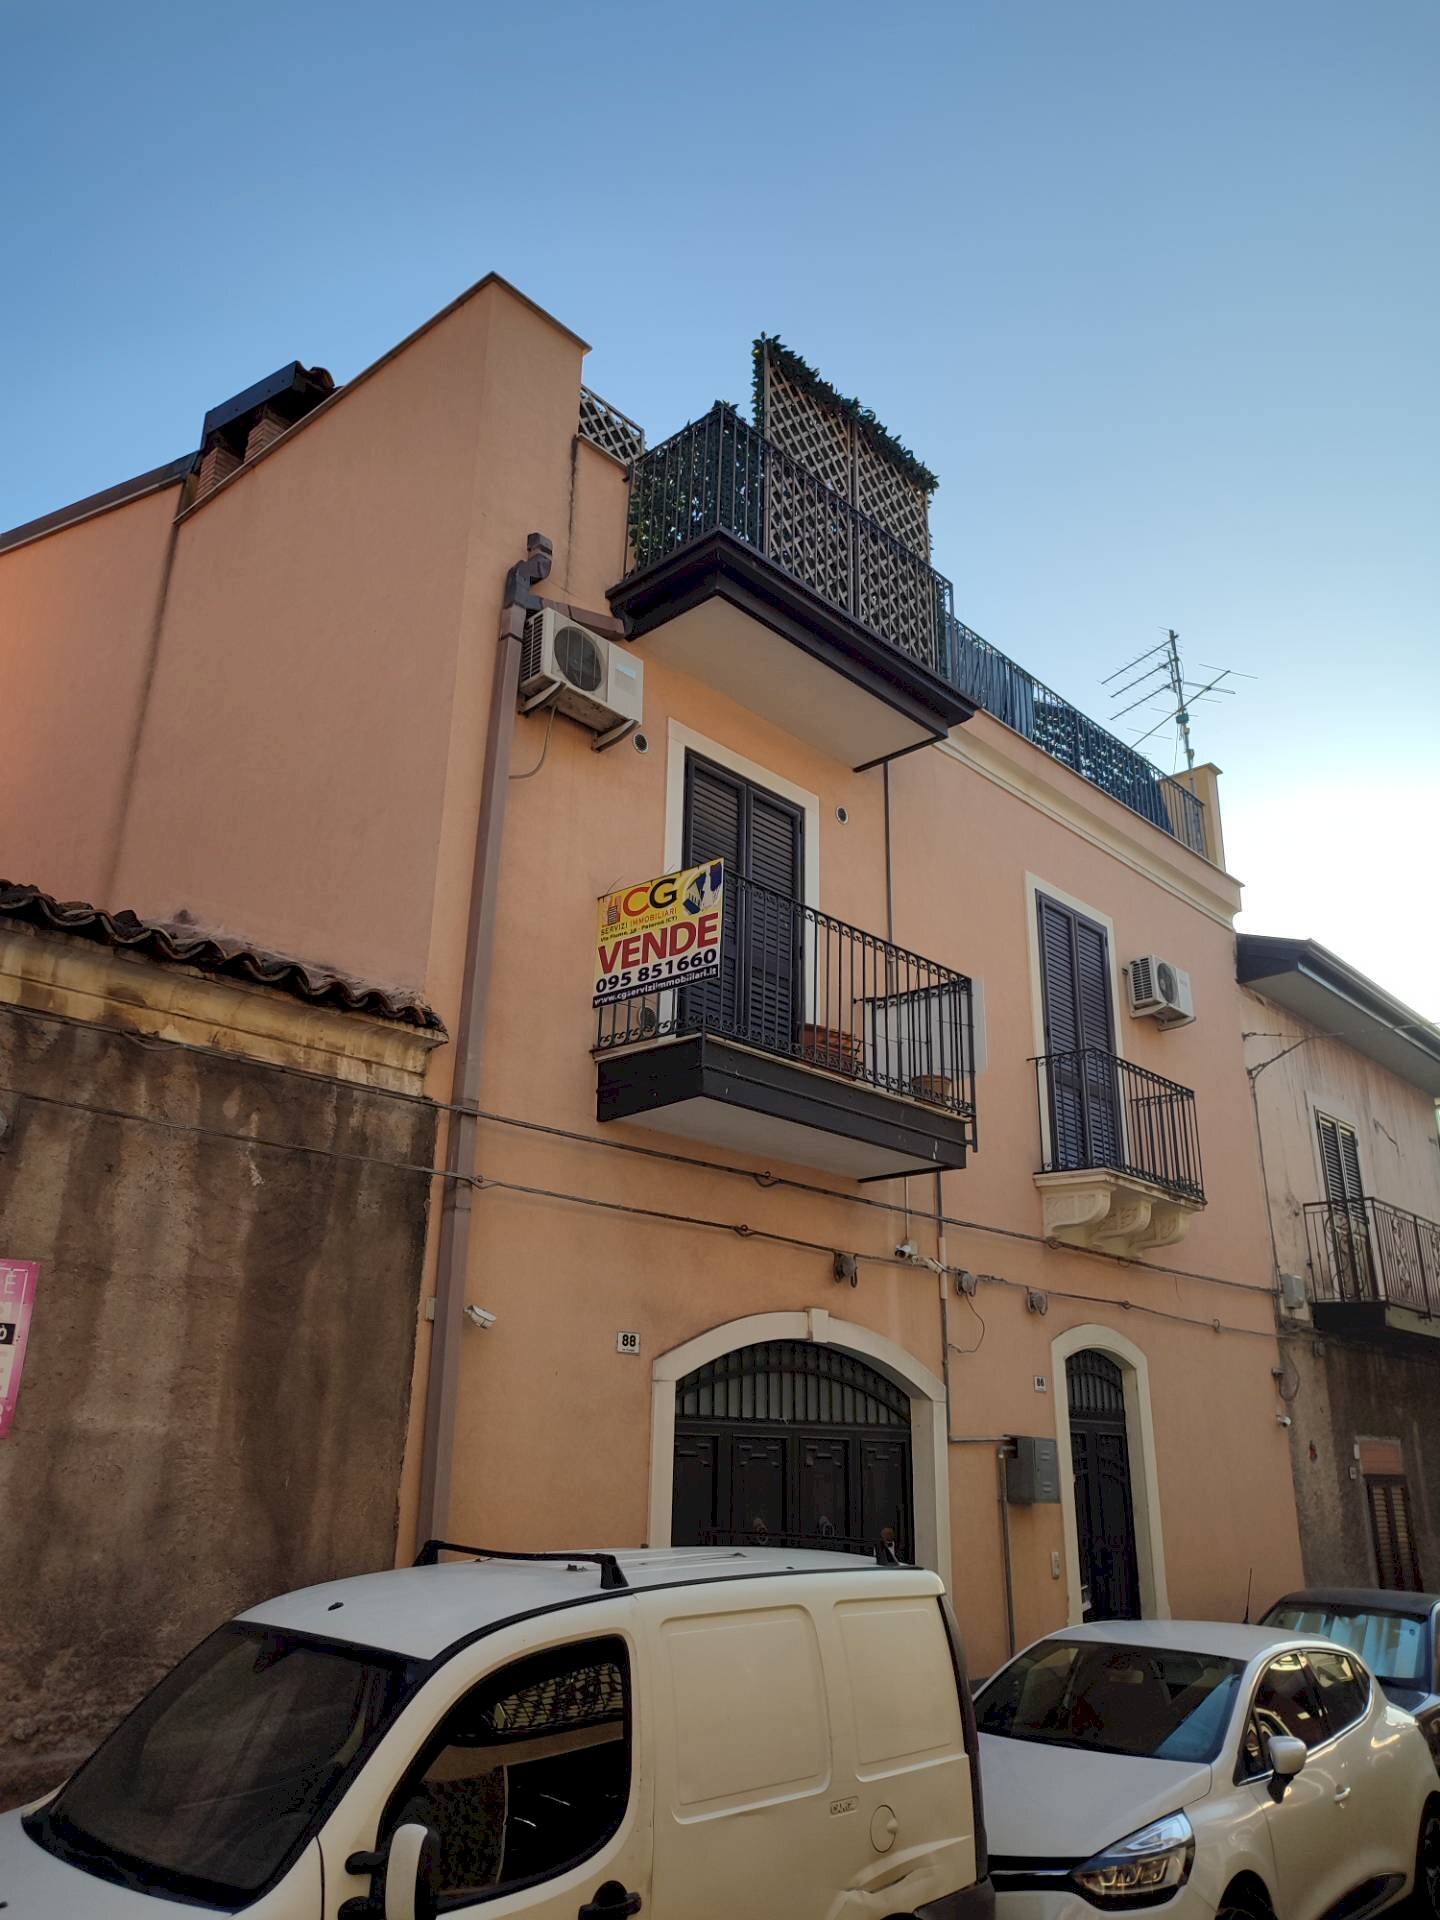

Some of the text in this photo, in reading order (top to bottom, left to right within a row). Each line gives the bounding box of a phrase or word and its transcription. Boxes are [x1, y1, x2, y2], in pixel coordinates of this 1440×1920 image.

[622, 878, 678, 917] CG
[600, 907, 677, 936] SERVIZI IMMOBILIARI
[597, 912, 719, 975] VENDE
[594, 967, 717, 1005] www.cgserviziimmobiliari.it
[595, 948, 717, 993] 095 851660
[621, 1334, 637, 1347] 88
